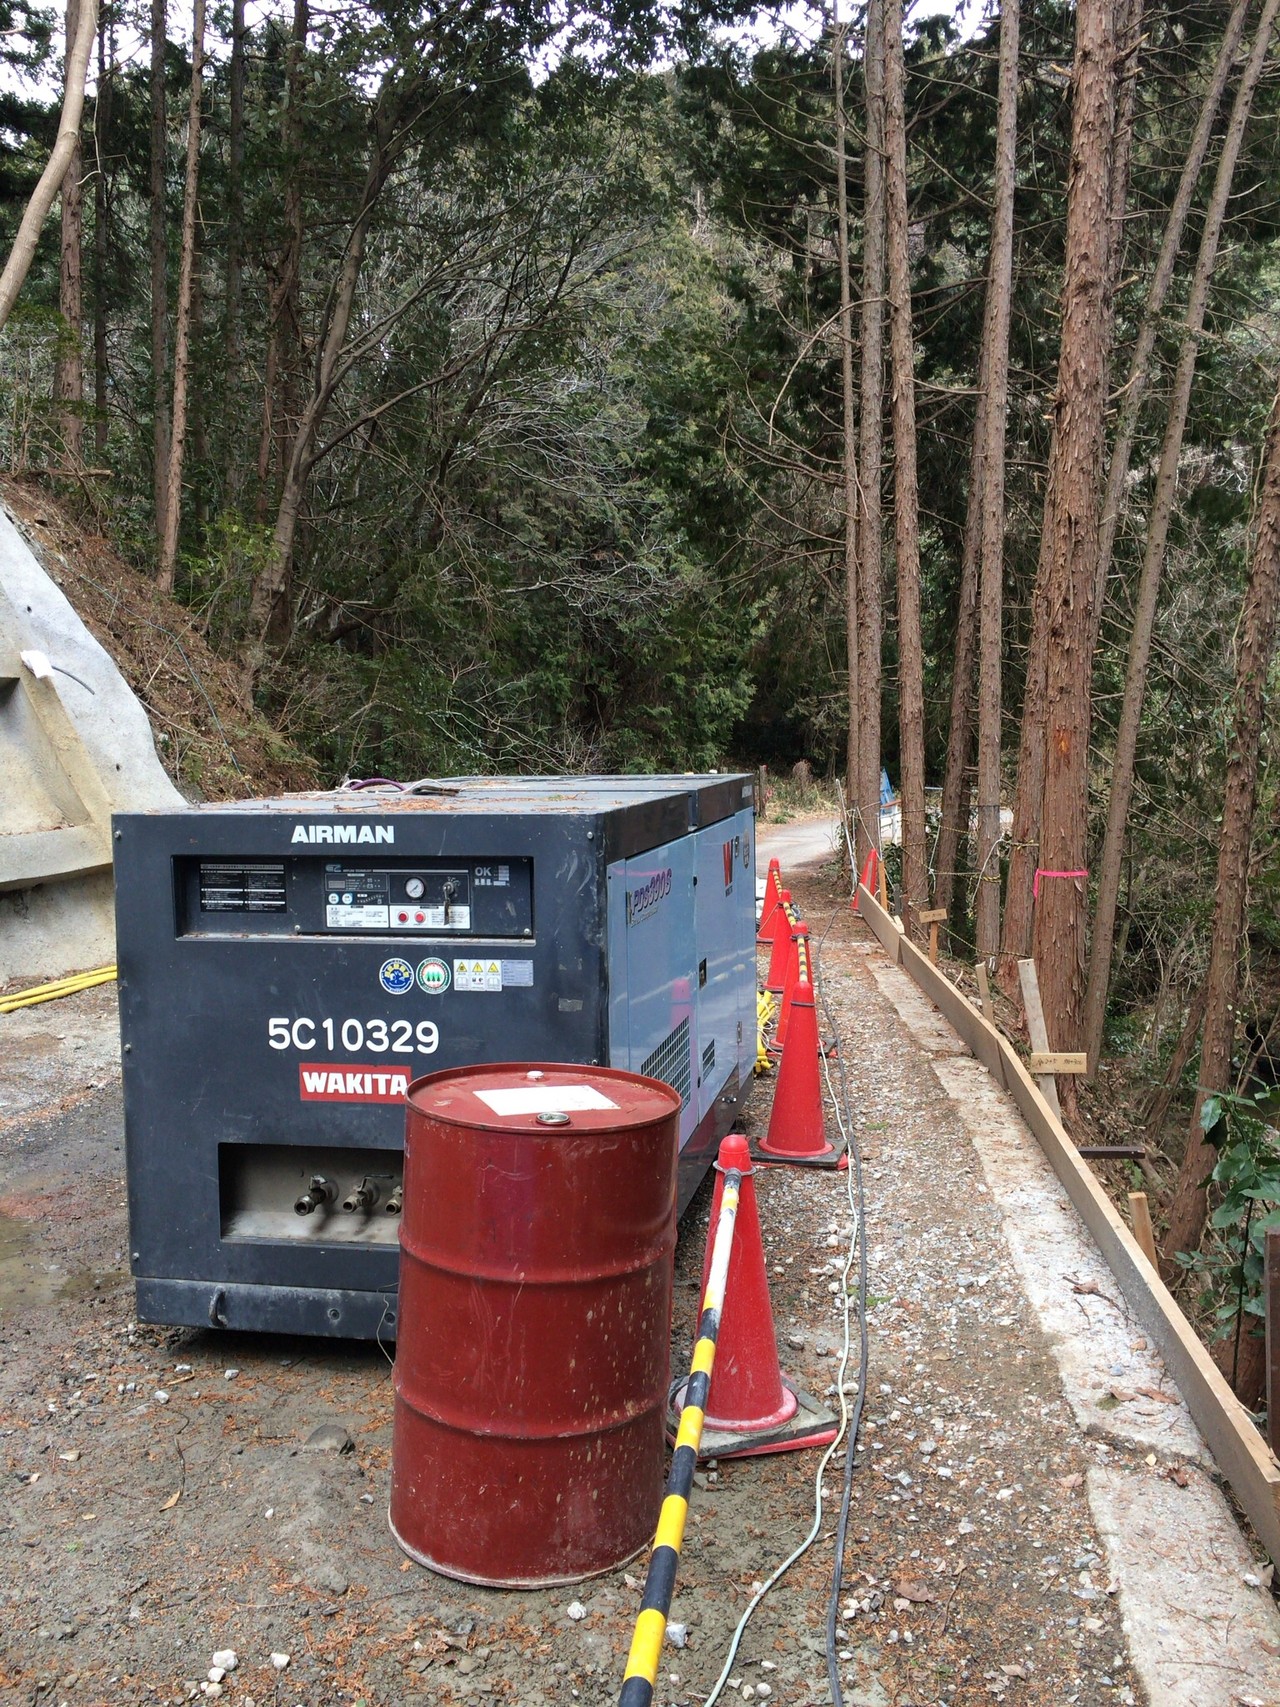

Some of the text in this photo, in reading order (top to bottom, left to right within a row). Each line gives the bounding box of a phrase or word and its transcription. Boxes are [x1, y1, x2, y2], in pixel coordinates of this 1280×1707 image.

[291, 825, 395, 844] AIRMAN
[474, 866, 492, 877] OK
[268, 1017, 440, 1054] 5C10329
[302, 1071, 408, 1096] WAKITA
